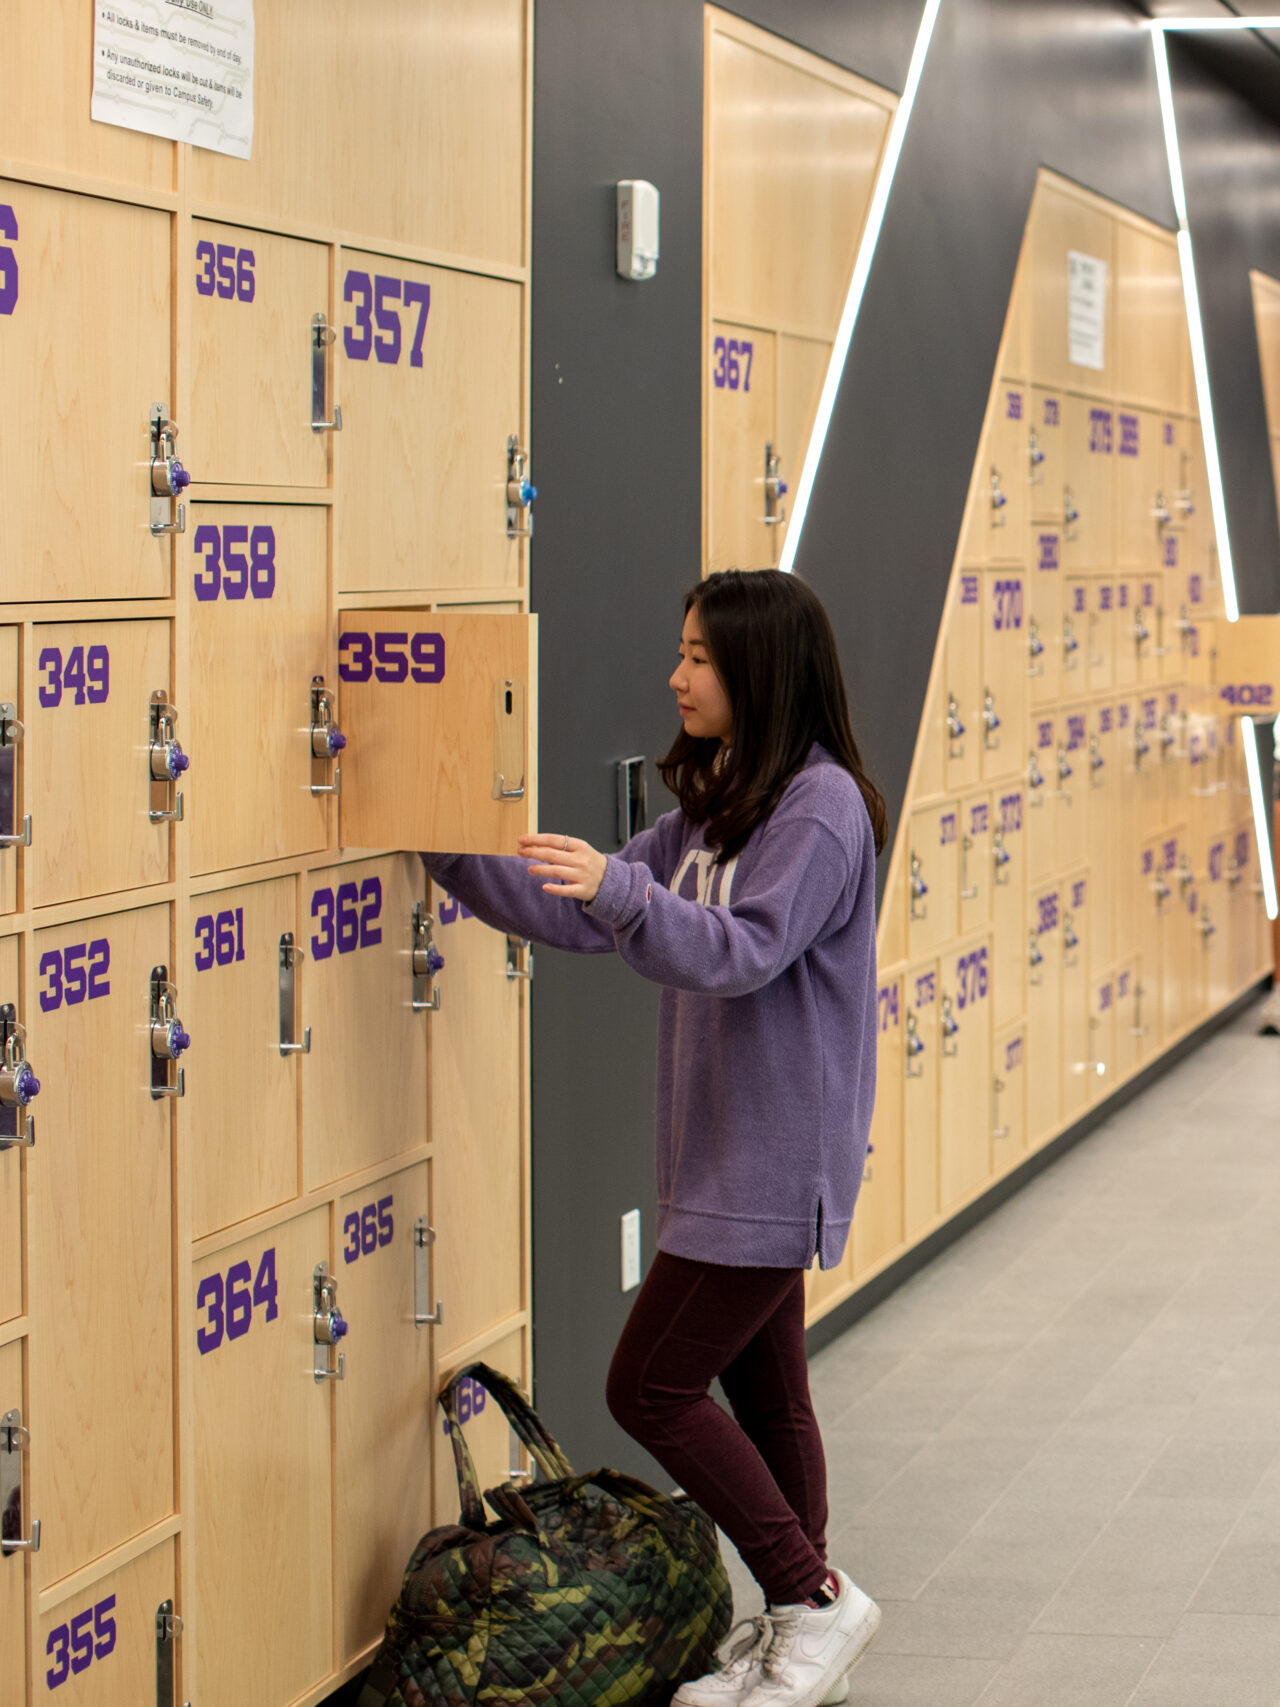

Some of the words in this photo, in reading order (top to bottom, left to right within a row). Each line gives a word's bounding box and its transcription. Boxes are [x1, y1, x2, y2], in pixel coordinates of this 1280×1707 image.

[107, 11, 115, 23] All
[117, 14, 133, 29] locks
[135, 19, 140, 31] &
[141, 21, 158, 37] items
[160, 29, 177, 41] must
[179, 32, 187, 44] be
[188, 37, 209, 52] removed
[210, 43, 216, 56] by
[217, 47, 226, 58] end
[227, 50, 232, 60] of
[106, 49, 118, 65] Any
[120, 54, 161, 75] unauthorized
[162, 64, 180, 80] locks
[181, 71, 191, 82] will
[192, 72, 199, 84] be
[199, 78, 208, 88] cut
[209, 79, 213, 89] &
[214, 80, 226, 94] items
[227, 86, 235, 97] will
[236, 88, 242, 99] be
[106, 69, 136, 87] discarded
[137, 79, 145, 89] or
[145, 81, 163, 95] given
[164, 85, 172, 97] to
[173, 86, 196, 104] Campus
[196, 241, 255, 303] 356
[344, 270, 430, 368] 357
[714, 336, 754, 392] 367
[194, 525, 275, 601] 358
[39, 645, 109, 708] 349
[338, 632, 445, 683] 359
[1220, 684, 1274, 707] 402
[195, 908, 245, 971] 361
[311, 877, 382, 960] 362
[40, 938, 110, 1012] 352
[956, 946, 988, 1010] 376
[877, 983, 899, 1032] 74
[344, 1195, 393, 1264] 365
[197, 1247, 278, 1355] 364
[443, 1376, 486, 1435] 66
[46, 1594, 116, 1690] 355
